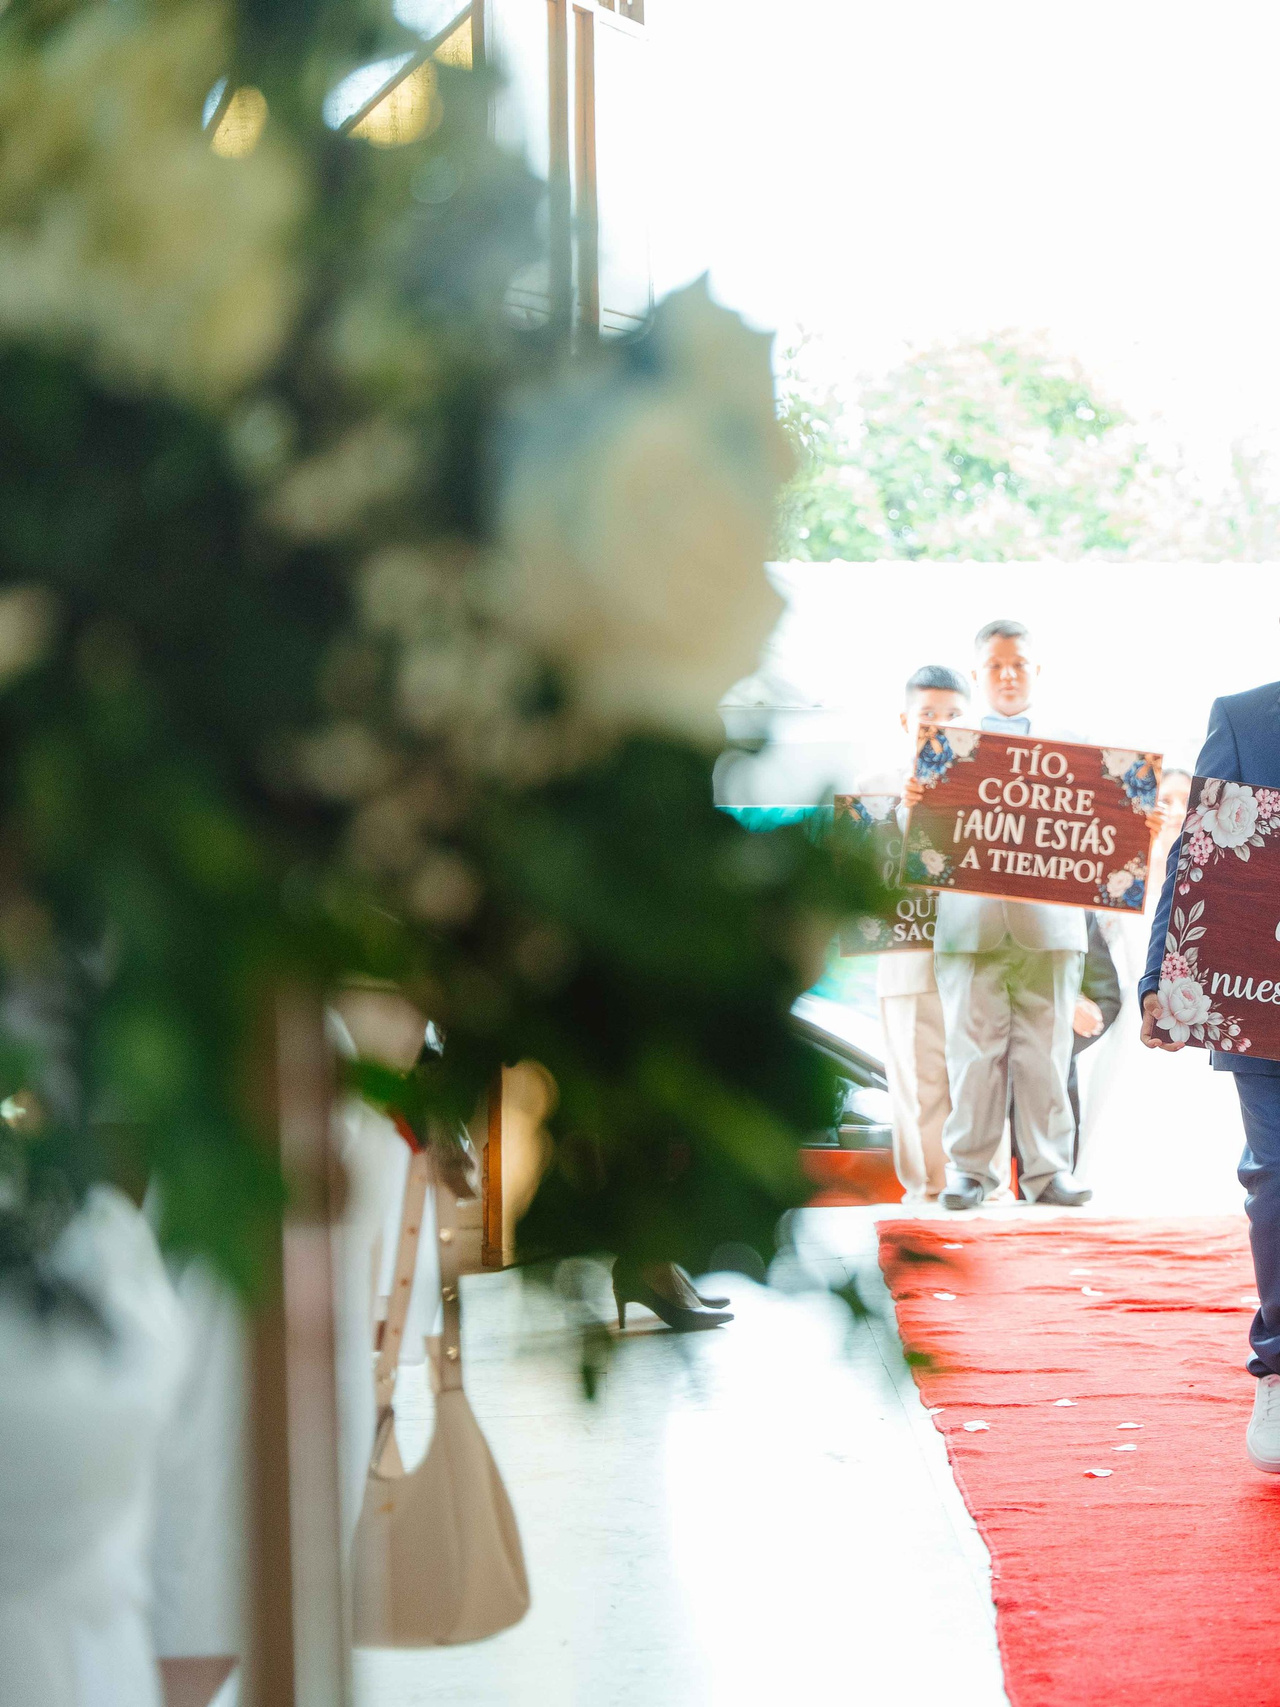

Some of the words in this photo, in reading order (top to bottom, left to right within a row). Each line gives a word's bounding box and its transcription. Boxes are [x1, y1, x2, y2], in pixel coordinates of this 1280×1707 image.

[1006, 744, 1075, 784] TÍO,
[977, 776, 1095, 816] CÓRRE
[953, 805, 1025, 845] ¡AÚN
[1035, 817, 1117, 856] ESTÁS
[959, 846, 981, 870] A
[987, 848, 1103, 883] TIEMPO!
